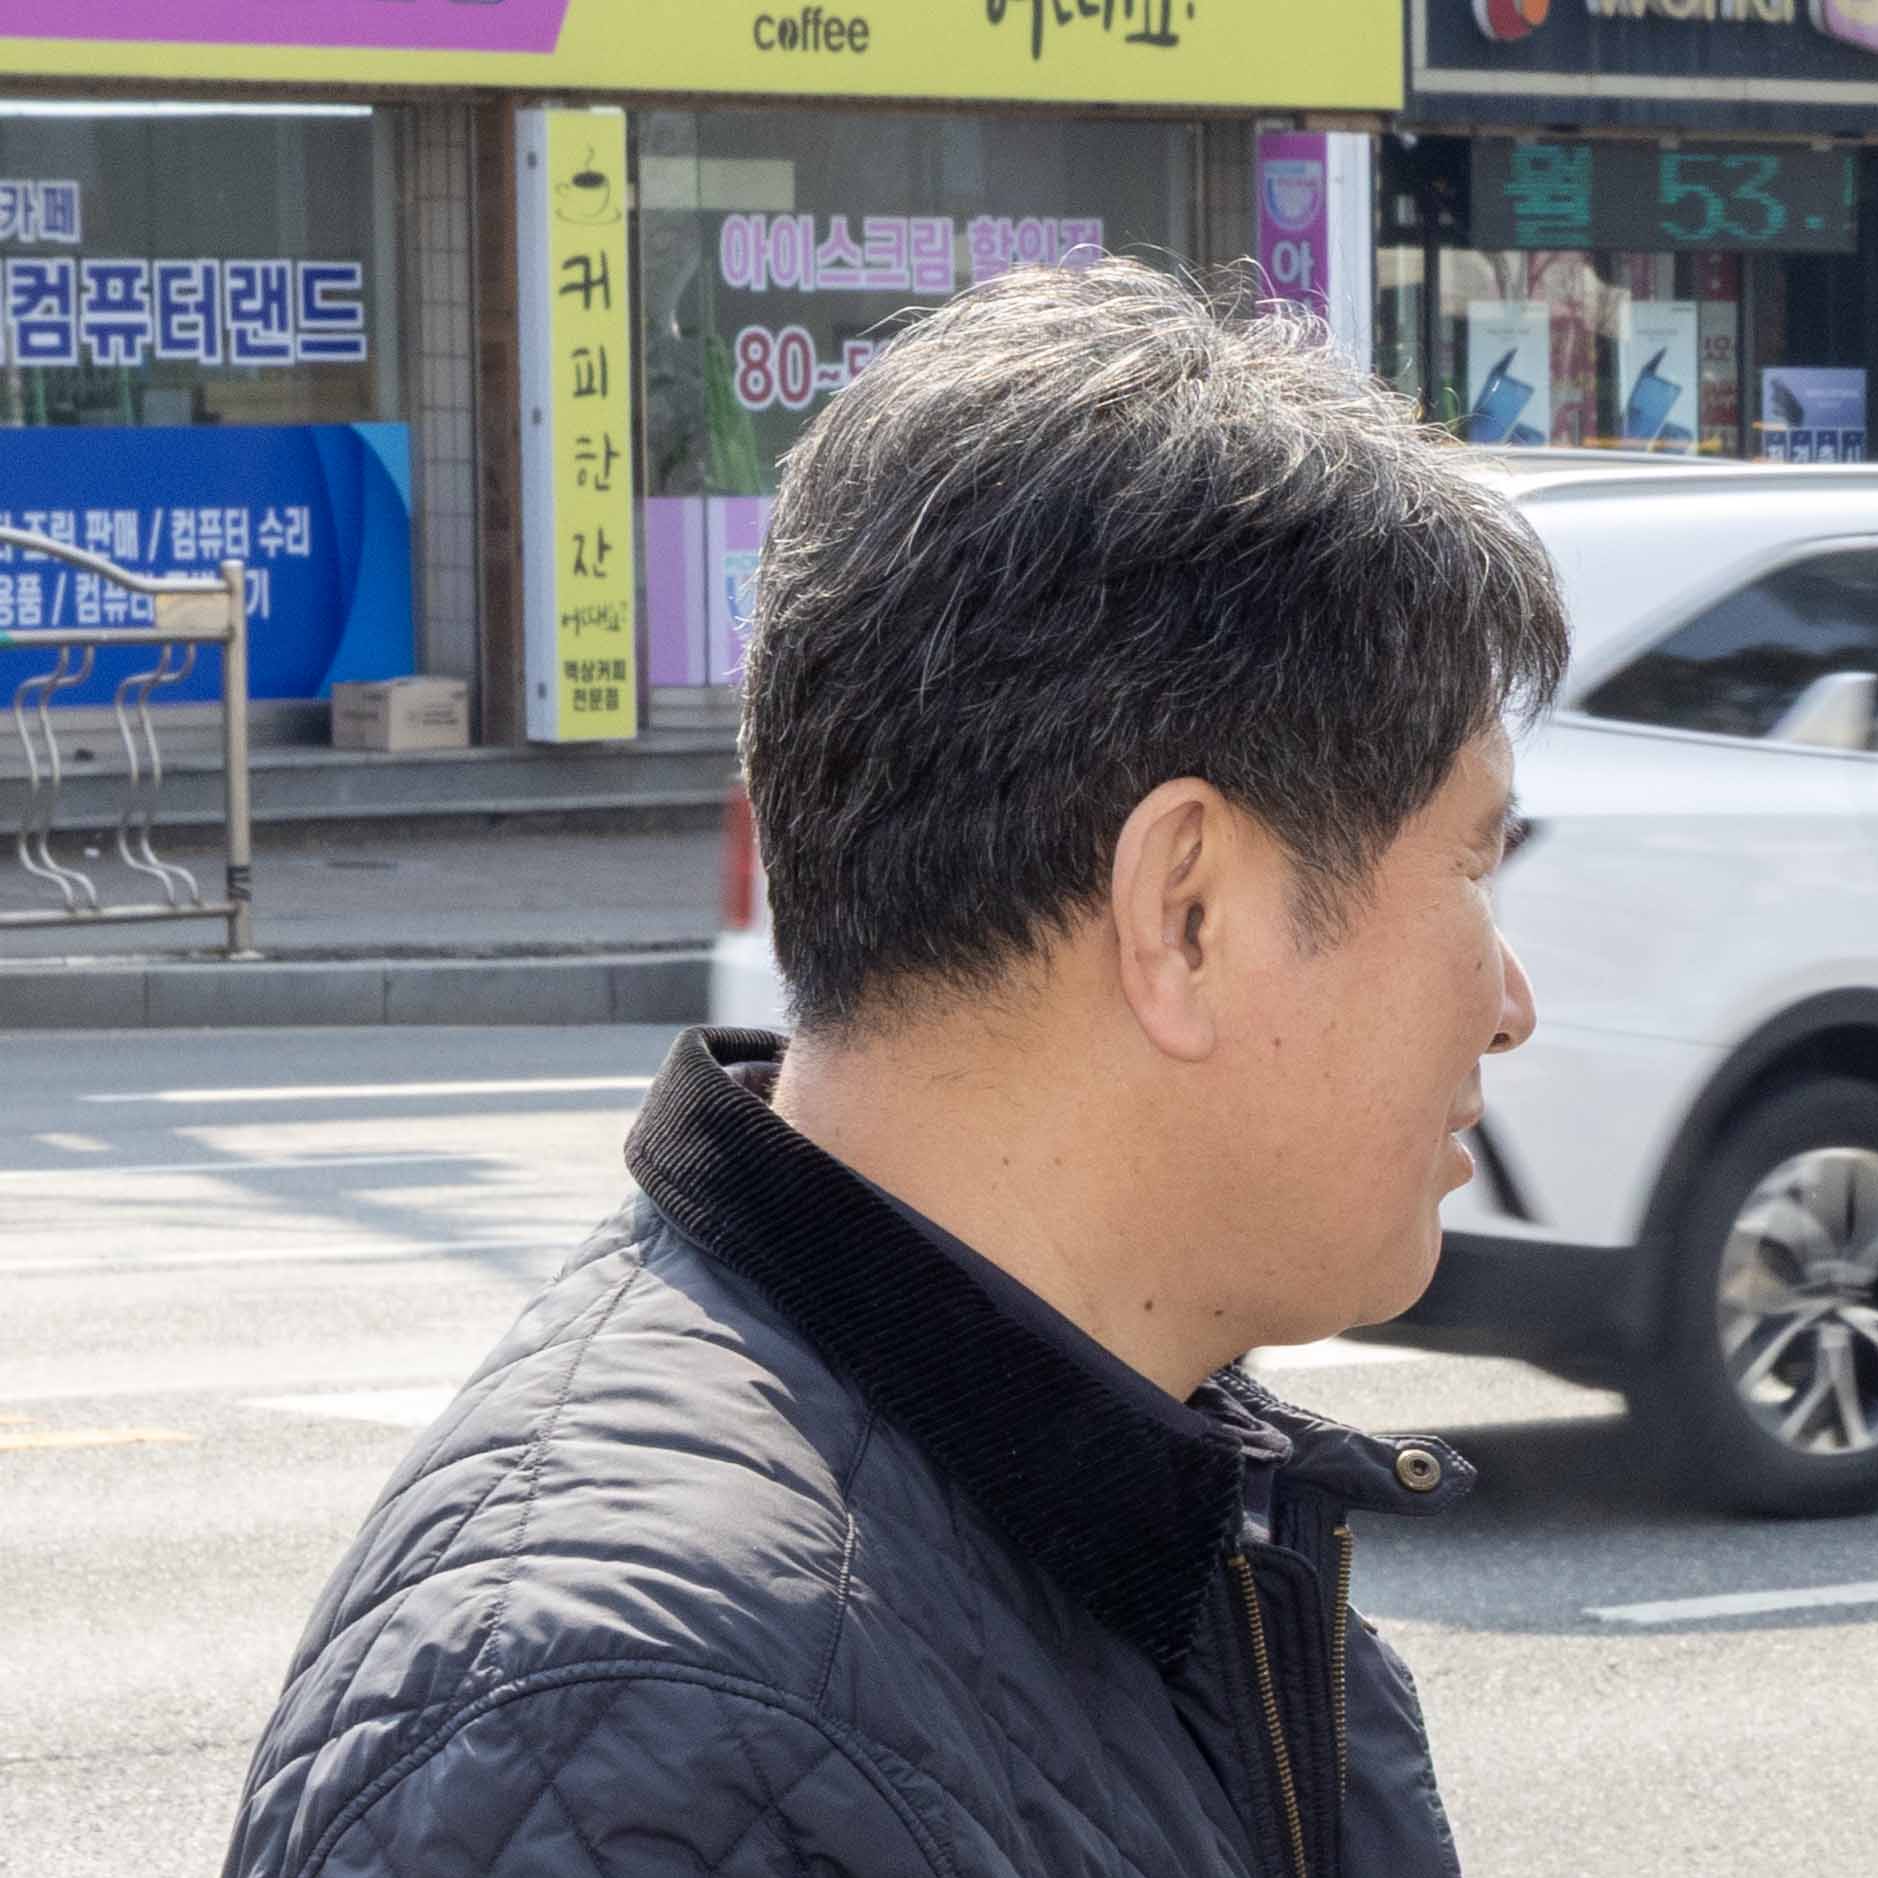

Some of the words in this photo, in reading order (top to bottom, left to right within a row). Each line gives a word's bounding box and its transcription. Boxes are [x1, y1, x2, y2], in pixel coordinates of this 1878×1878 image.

[720, 214, 956, 293] 아이스크림
[171, 508, 249, 560] 컴퓨터
[258, 506, 310, 558] 수리
